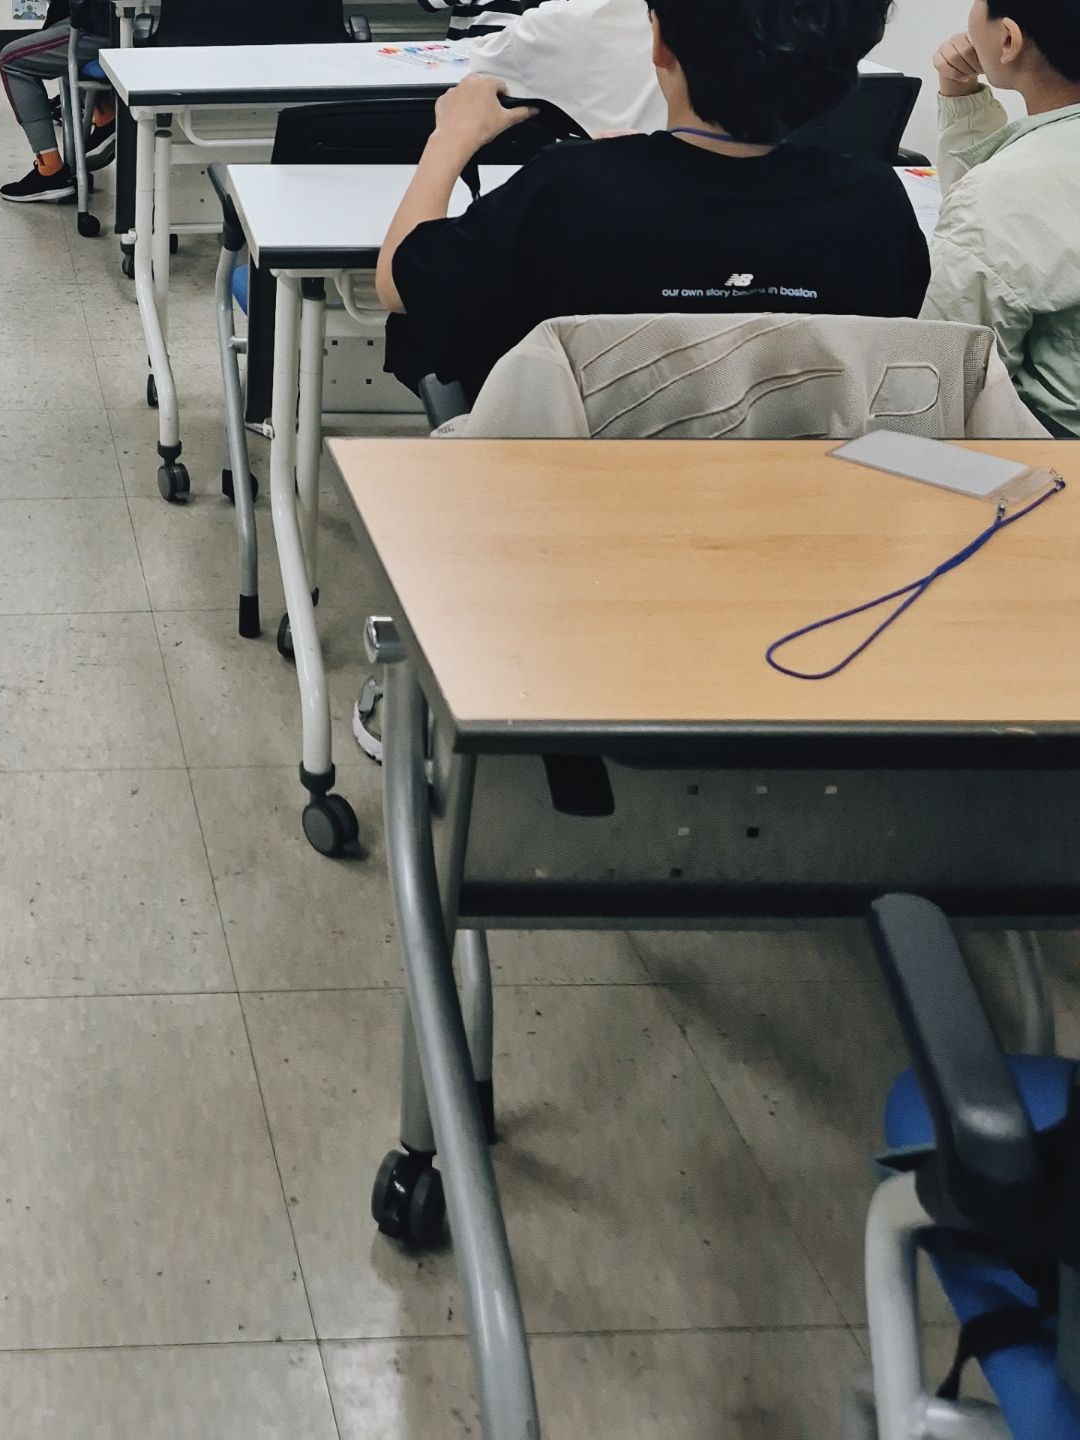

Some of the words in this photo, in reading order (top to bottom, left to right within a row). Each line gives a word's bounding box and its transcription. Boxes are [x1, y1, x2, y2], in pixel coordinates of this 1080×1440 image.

[661, 288, 679, 297] our
[681, 288, 704, 297] own
[706, 287, 731, 298] story
[780, 285, 818, 299] boston
